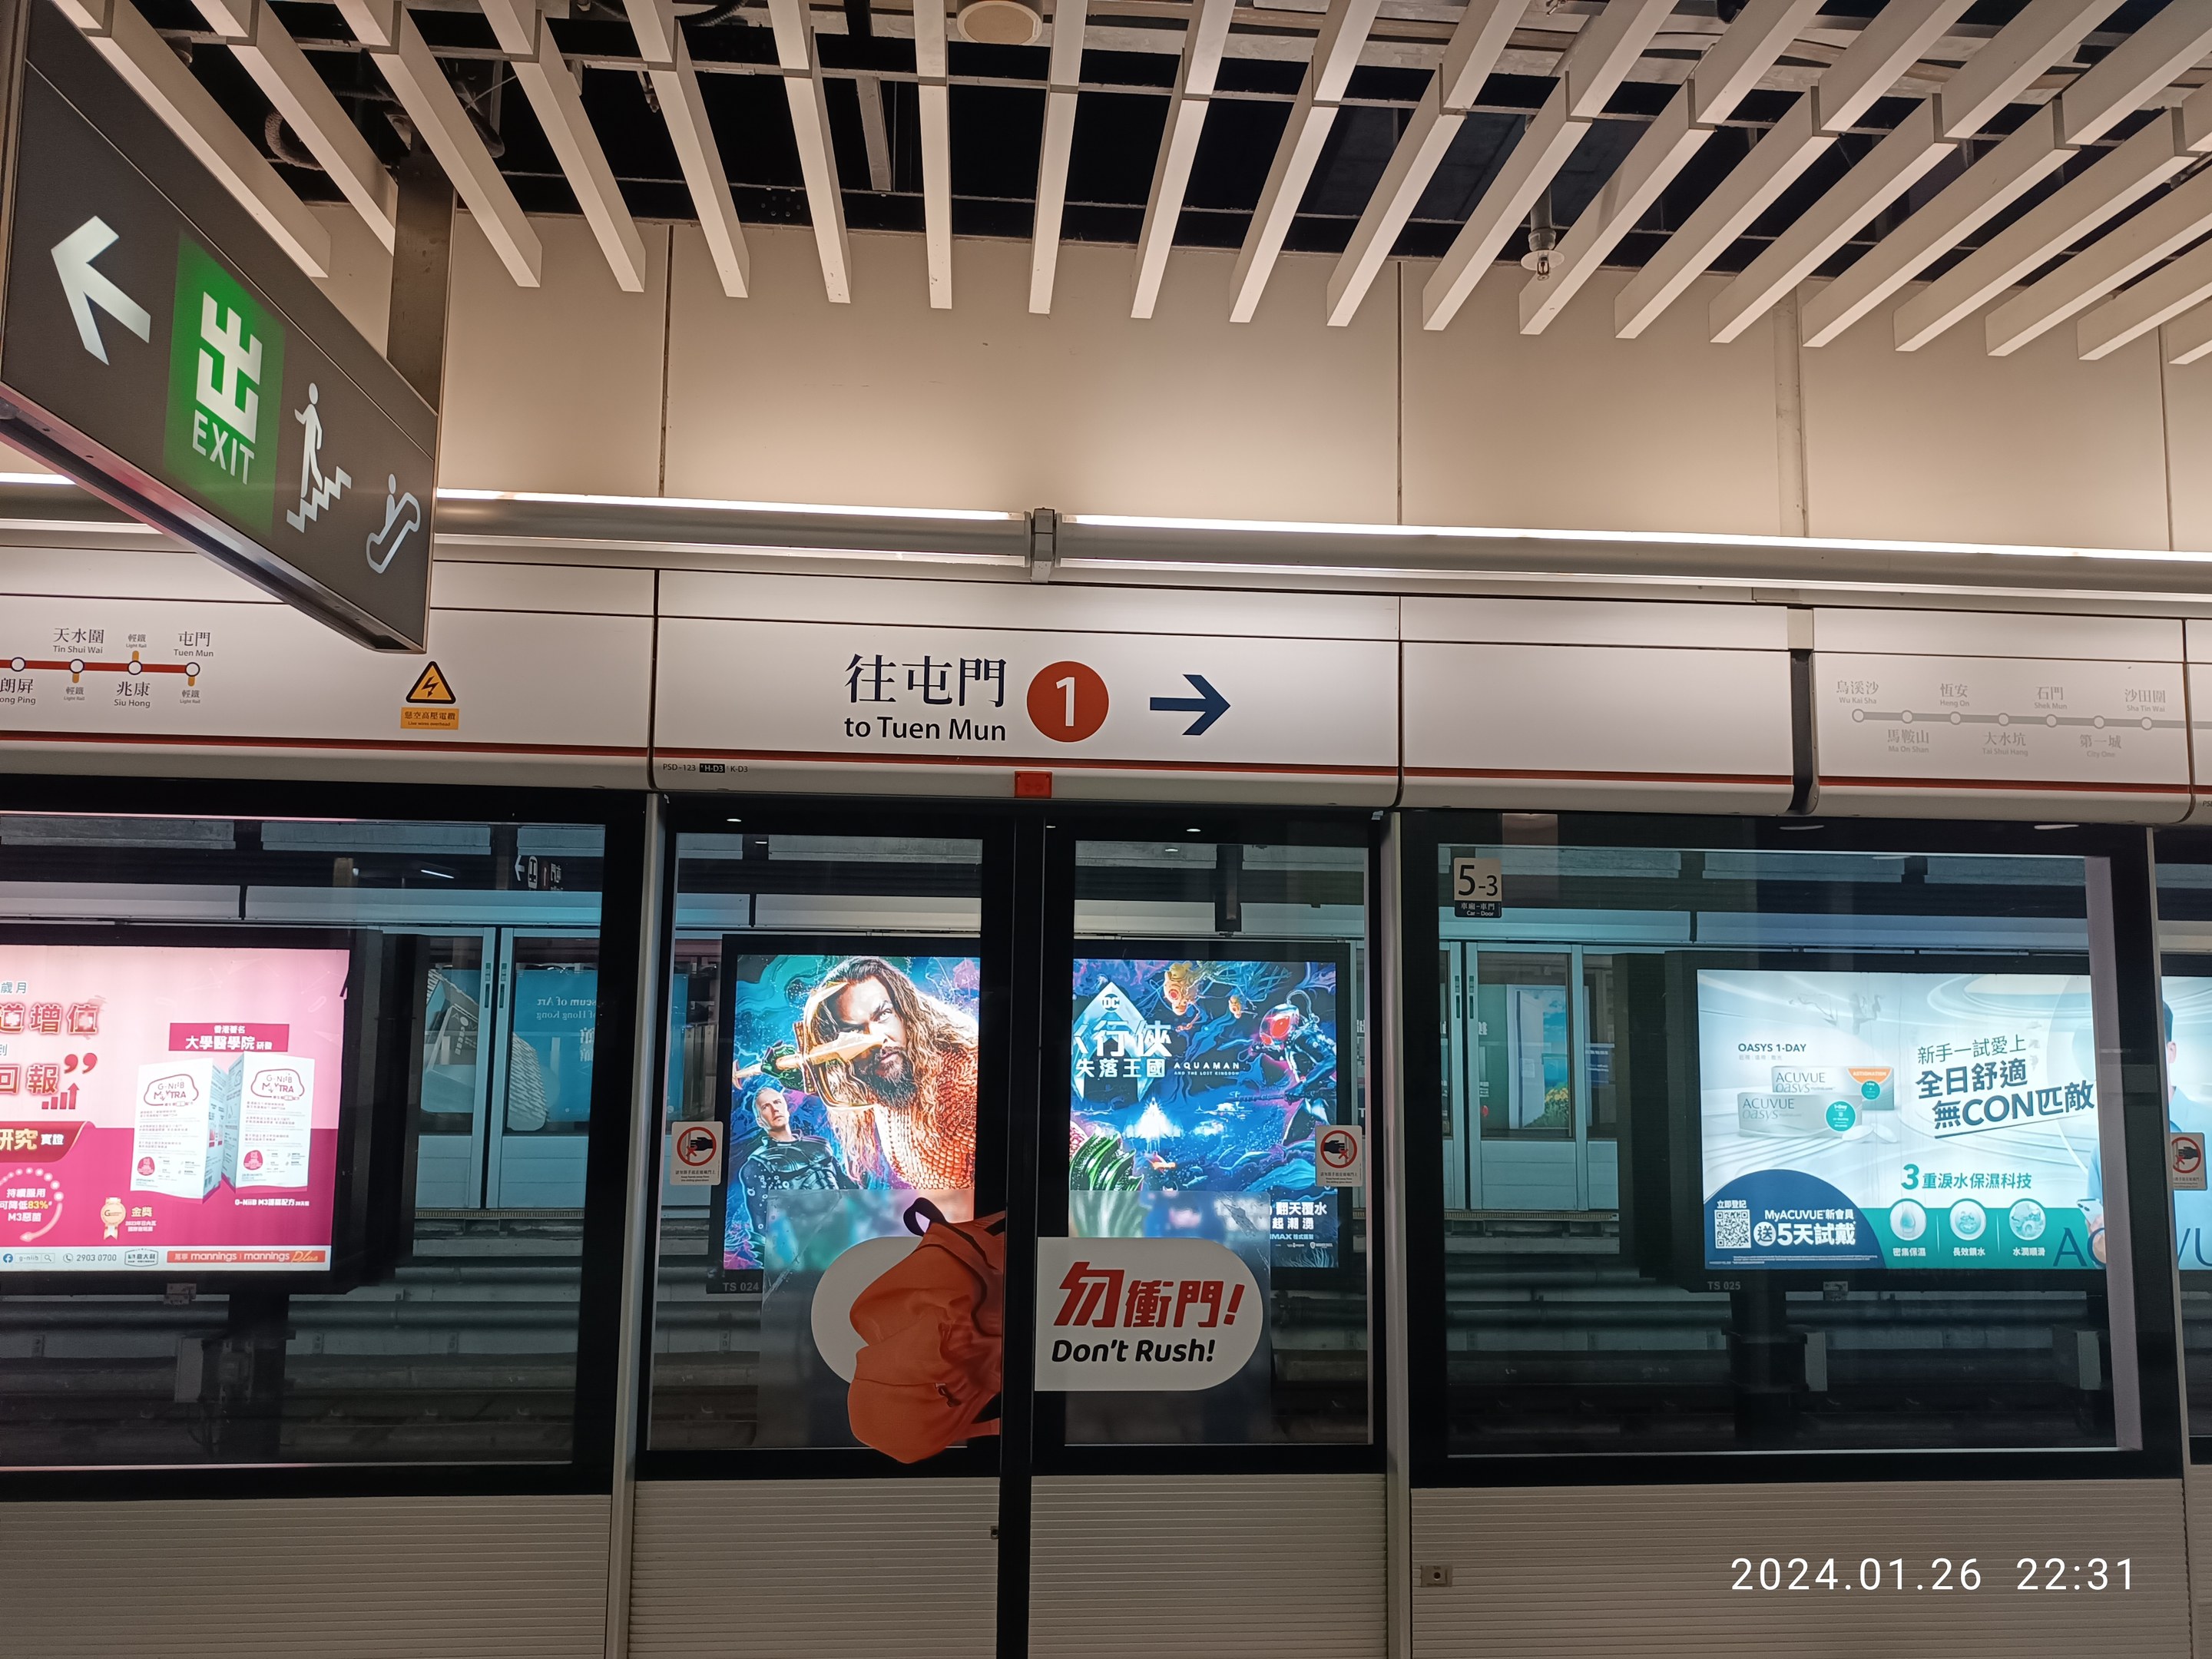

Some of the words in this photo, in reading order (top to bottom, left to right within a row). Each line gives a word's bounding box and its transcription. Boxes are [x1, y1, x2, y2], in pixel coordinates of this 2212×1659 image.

[192, 409, 255, 485] EXIT
[53, 628, 104, 644] 天水圍
[177, 631, 211, 647] 屯門
[68, 645, 86, 654] Shui
[0, 677, 35, 694] 朗屏
[844, 653, 1007, 708] 往屯門
[1836, 680, 1879, 695] 烏溪沙
[116, 680, 151, 697] 兆康
[2036, 686, 2064, 700] 石門
[17, 697, 36, 705] Ping
[128, 700, 151, 708] Hong
[1055, 676, 1075, 727] 1
[2124, 689, 2166, 704] 沙田圍
[844, 717, 871, 738] to
[876, 716, 941, 740] Tuen
[949, 717, 1007, 742] Mun
[1887, 729, 1929, 744] 馬鞍山
[1983, 731, 2027, 747] 大水坑
[2079, 734, 2122, 749] 第一城
[2010, 748, 2028, 757] Hang
[2086, 750, 2100, 759] City
[1458, 864, 1498, 896] 5-3
[1102, 995, 1121, 1010] DC
[184, 1035, 255, 1051] 大學醫學院
[1738, 1043, 1773, 1052] OASYS
[1777, 1043, 1806, 1052] 1-DAY
[1917, 1034, 2026, 1065] 新手一試愛上
[1075, 1058, 1166, 1078] 失落王國
[1174, 1061, 1240, 1070] AQUAMAN
[1776, 1071, 1826, 1083] ACUVUE
[1916, 1058, 2028, 1100] 全日舒適
[1743, 1098, 1795, 1109] ACUVUE
[1931, 1079, 2095, 1130] 無CON匹敵
[1276, 1201, 1328, 1216] 翻天覆水
[1717, 1200, 1747, 1209] 立即登記
[190, 1252, 237, 1262] mannings
[243, 1252, 290, 1262] mannings
[722, 1282, 737, 1291] TS
[740, 1282, 760, 1291] 024
[1707, 1281, 1720, 1290] TS
[1724, 1281, 1741, 1290] 025
[1053, 1261, 1245, 1328] 勿衝門!
[1051, 1339, 1129, 1363] Don't
[1135, 1338, 1216, 1363] Rush!
